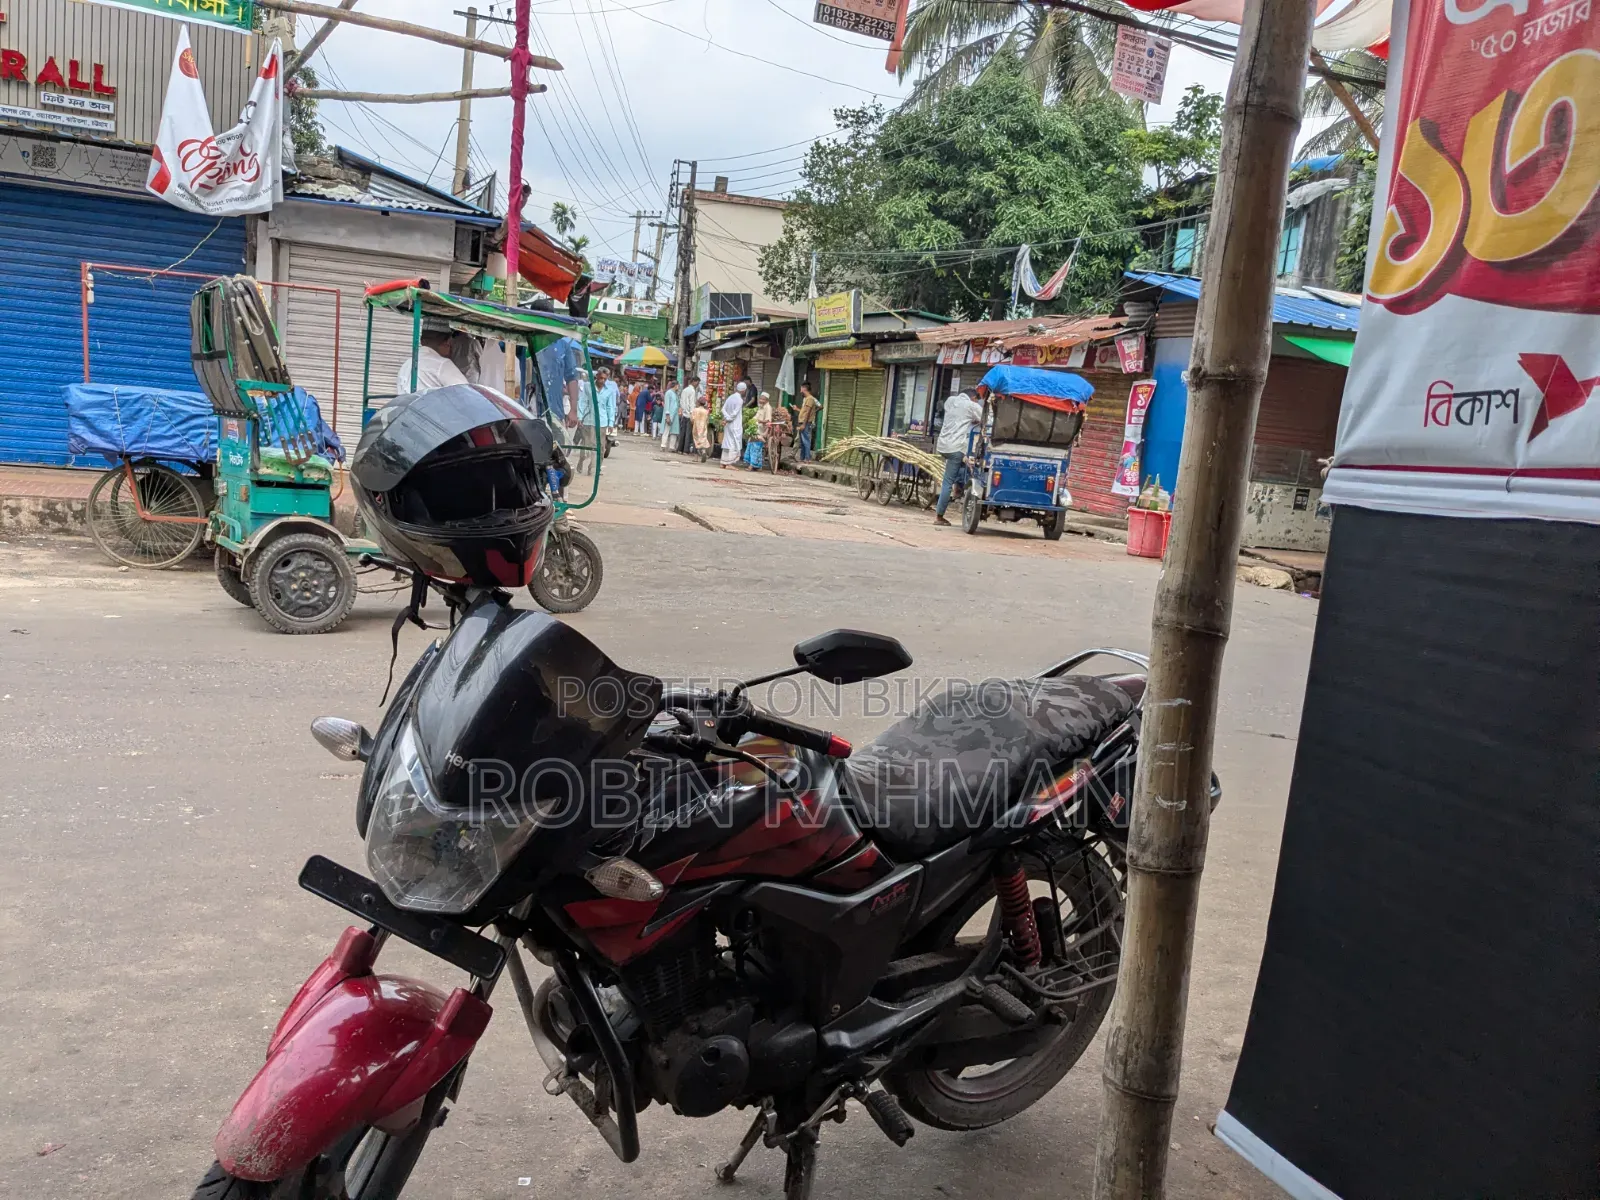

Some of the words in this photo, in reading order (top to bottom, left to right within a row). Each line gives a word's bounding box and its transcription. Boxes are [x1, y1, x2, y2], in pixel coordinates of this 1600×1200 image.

[823, 15, 895, 40] 01907-581767
[824, 6, 896, 32] 01823-722796
[1521, 0, 1592, 46] হাজার
[43, 92, 65, 104] ফিট
[68, 97, 85, 108] ফর
[89, 101, 111, 111] অল
[1423, 380, 1519, 428] বিকাশ
[445, 750, 477, 775] Hero
